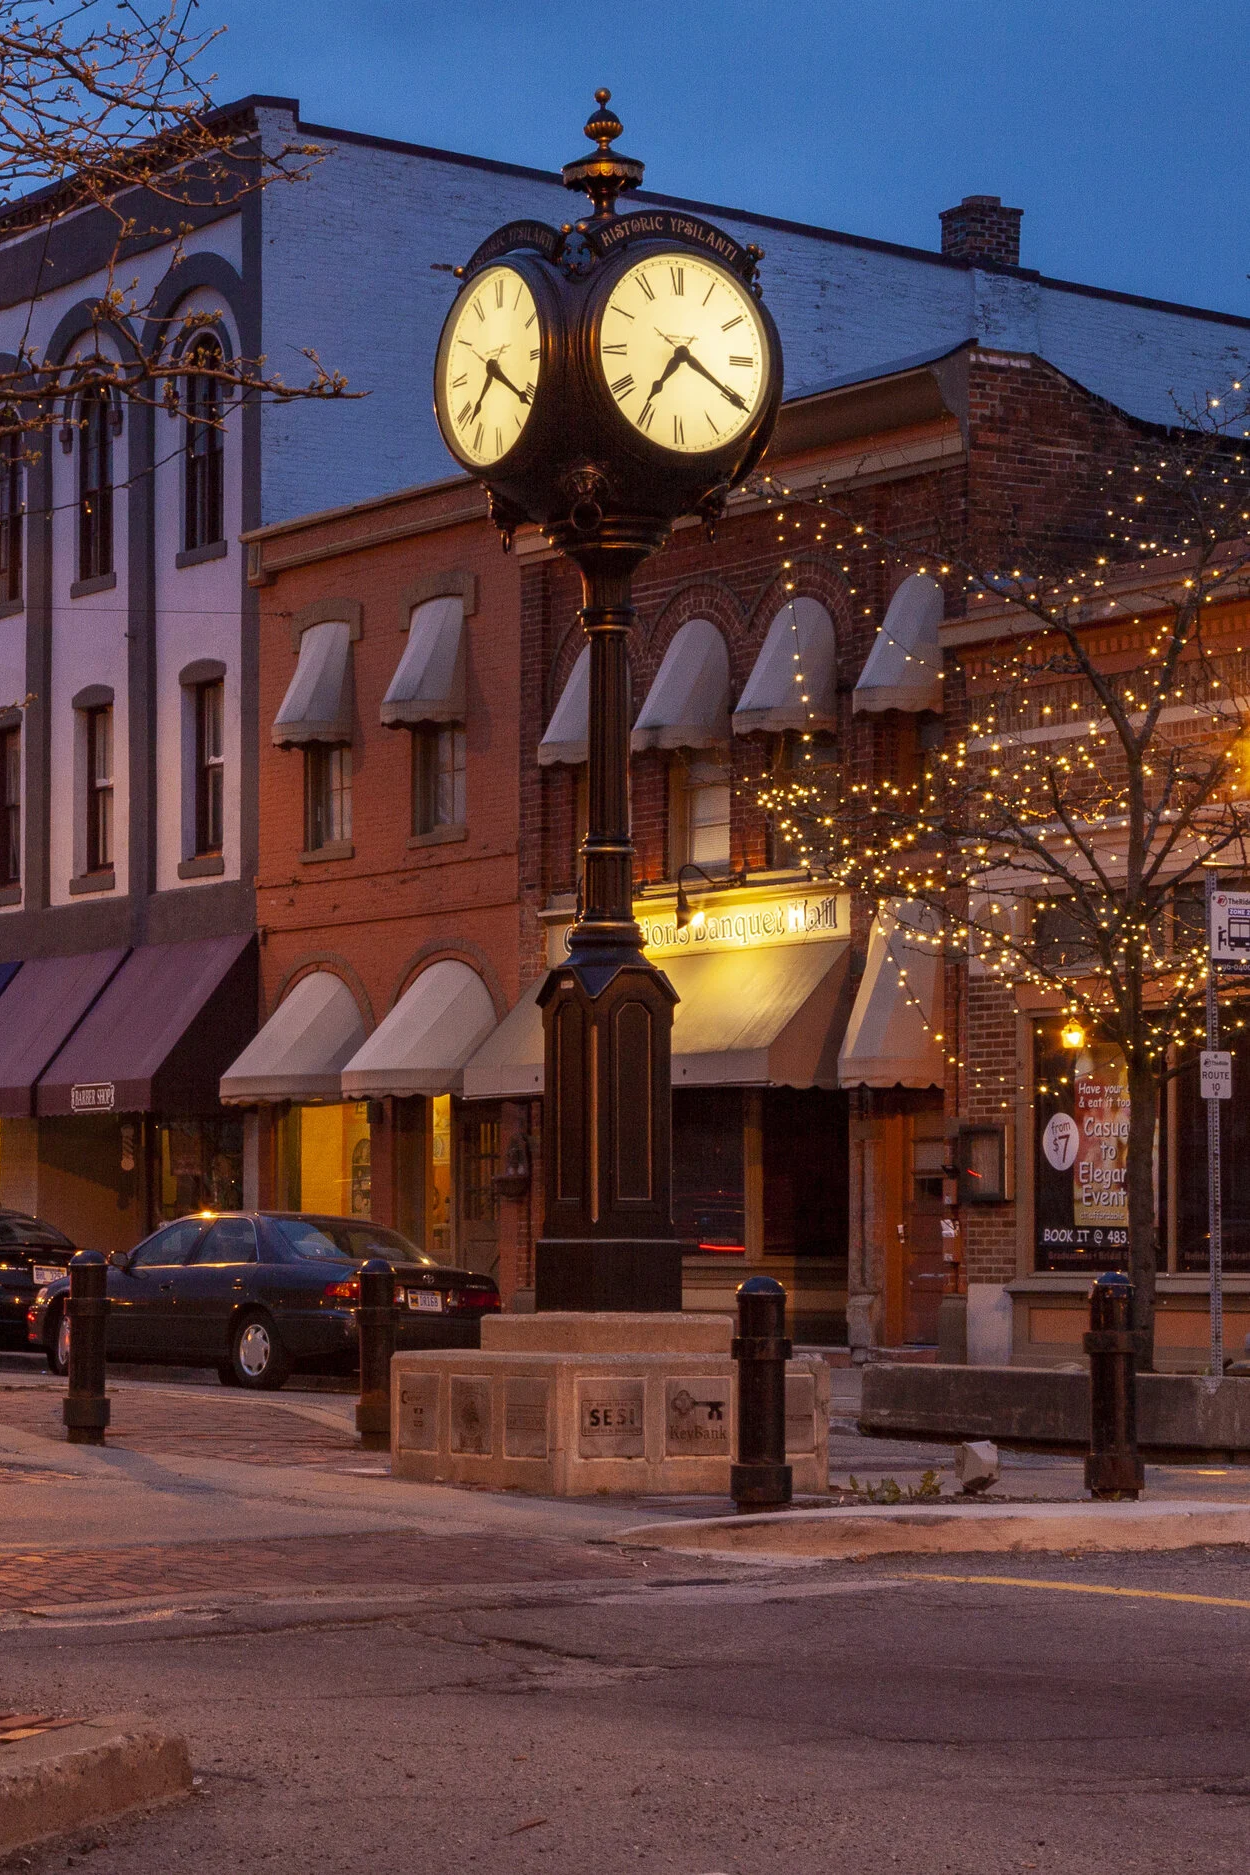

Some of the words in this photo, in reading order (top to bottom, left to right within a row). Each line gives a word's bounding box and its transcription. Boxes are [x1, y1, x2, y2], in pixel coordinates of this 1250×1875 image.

[600, 216, 664, 248] HISTORIC
[669, 217, 738, 262] YPSILANTI
[787, 894, 838, 932] Hall
[1202, 1071, 1230, 1080] ROUTE
[1078, 1083, 1101, 1095] Have
[1104, 1085, 1124, 1097] your
[1212, 1083, 1221, 1091] 10
[1078, 1096, 1085, 1108] &
[1088, 1098, 1102, 1108] eat
[1106, 1096, 1114, 1108] it
[1051, 1121, 1071, 1136] from
[1083, 1116, 1129, 1138] Casua
[1100, 1141, 1118, 1161] to
[1043, 1228, 1073, 1243] BOOK
[1076, 1230, 1090, 1243] IT
[1093, 1229, 1104, 1244] @
[589, 1408, 636, 1427] SESI
[669, 1425, 728, 1441] KeyBank
